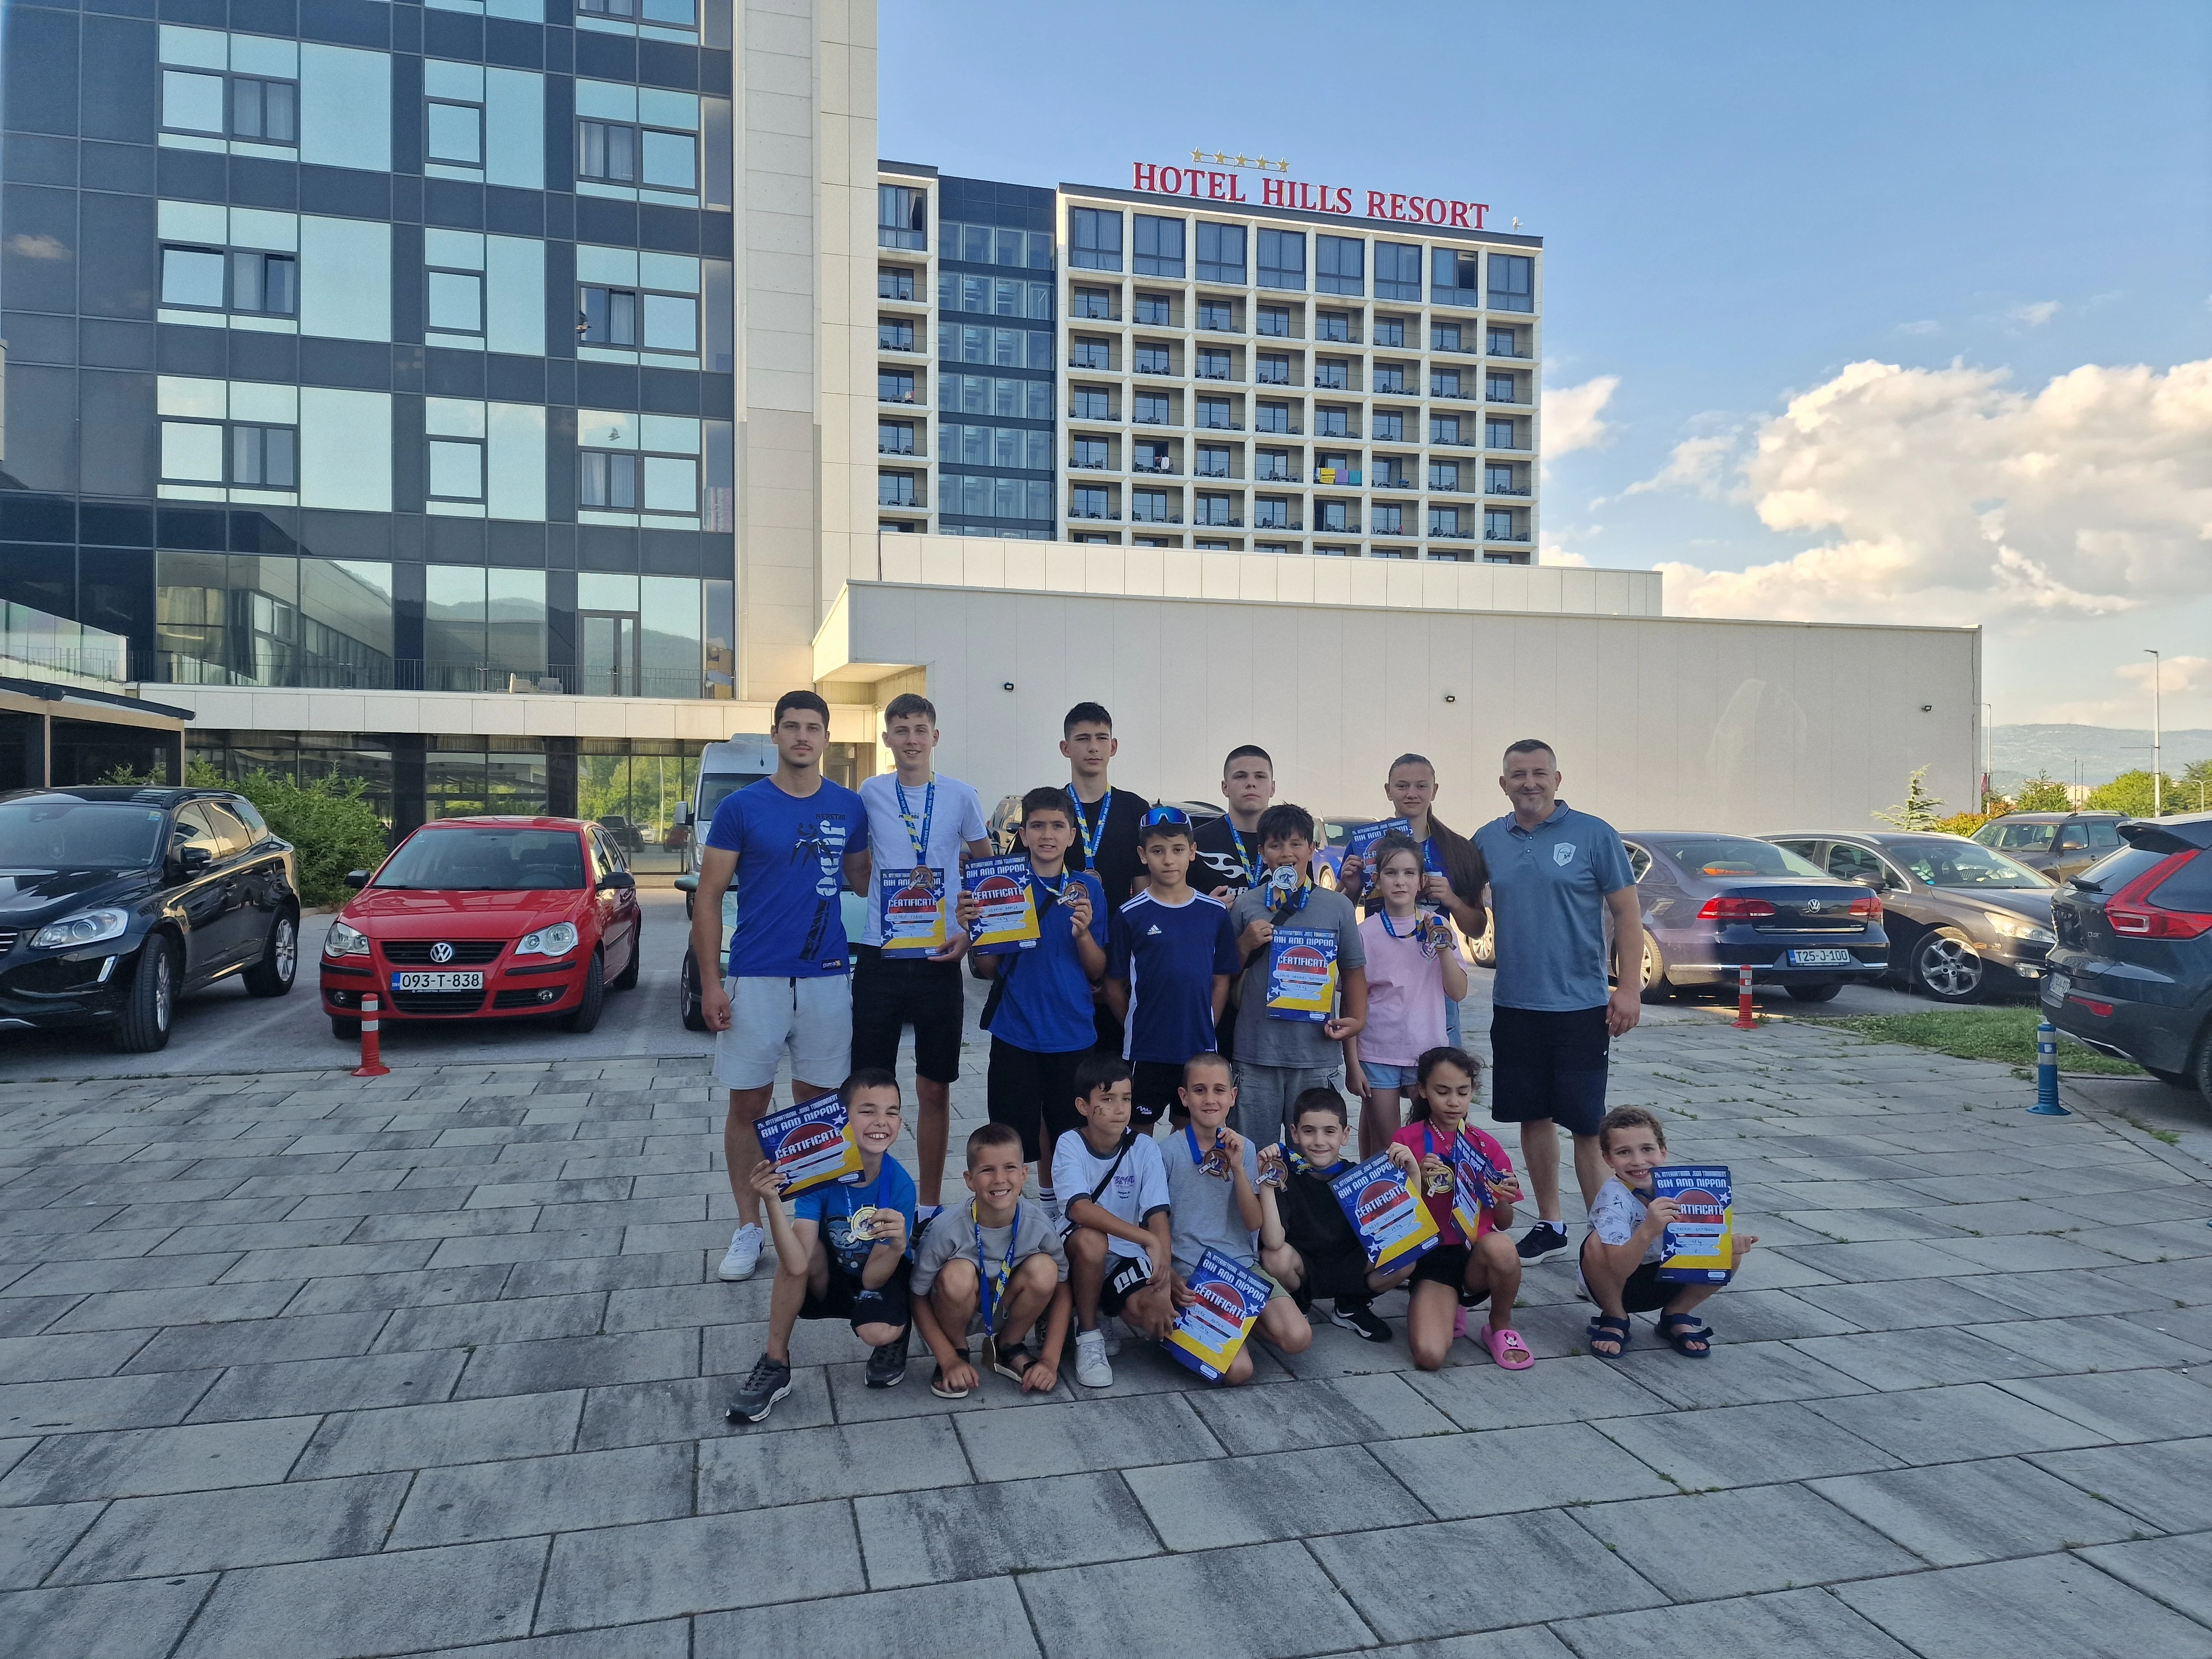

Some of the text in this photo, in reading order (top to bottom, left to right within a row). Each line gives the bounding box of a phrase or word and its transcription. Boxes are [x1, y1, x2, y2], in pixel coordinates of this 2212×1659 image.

[1133, 161, 1490, 229] HOTEL HILLS RESORT
[1367, 831, 1382, 839] AND
[966, 864, 1025, 879] BIH AND NIPPON
[972, 886, 1024, 900] CERTIFICATE
[888, 898, 937, 907] CERTIFICATE
[1274, 936, 1286, 944] BIH
[1306, 938, 1334, 947] NIPPON
[1277, 956, 1329, 968] CERTIFICATE
[1796, 950, 1848, 962] T25-J-100
[402, 974, 479, 988] 093-T-838
[760, 1102, 840, 1139] BIH AND NIPPON
[774, 1126, 842, 1160] CERTIFICATE
[1337, 1186, 1353, 1199] BIH
[1354, 1177, 1370, 1191] AND
[1657, 1178, 1727, 1188] BIH AND NIPPON
[1354, 1182, 1407, 1219] CERTIFICATE
[1676, 1203, 1725, 1215] ERTIFICATE
[1202, 1259, 1265, 1302] BIH AND NIPPON
[1194, 1283, 1248, 1321] CERTIFICATE
